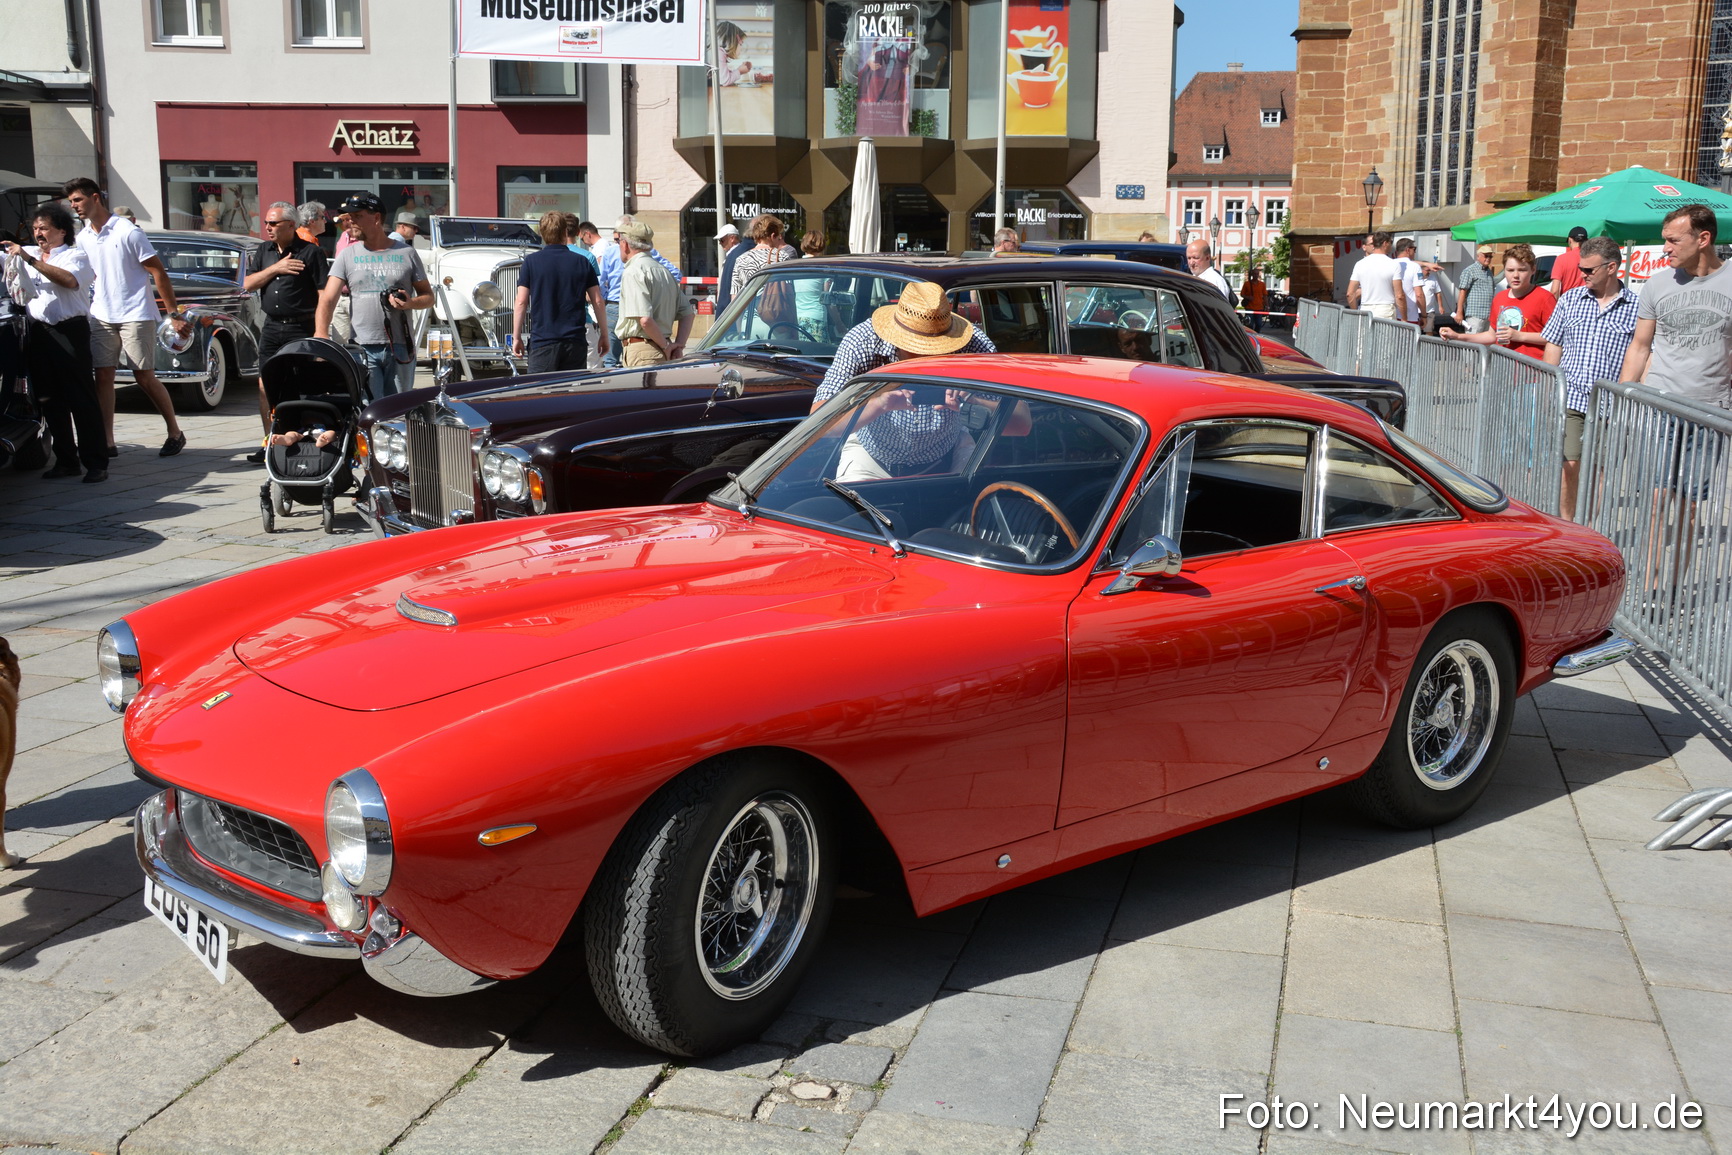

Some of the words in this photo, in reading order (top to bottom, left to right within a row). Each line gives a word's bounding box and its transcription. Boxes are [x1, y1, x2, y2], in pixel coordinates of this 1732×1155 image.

[863, 3, 880, 14] 100
[882, 2, 911, 13] Jahre
[859, 15, 903, 37] RACKL
[328, 119, 414, 149] Achatz
[1017, 208, 1047, 222] RACKL
[353, 255, 384, 264] OCEAN
[386, 254, 405, 263] SIDE
[1688, 289, 1732, 315] RENOWNED
[1671, 310, 1712, 327] SELVAGE
[197, 910, 220, 970] 50
